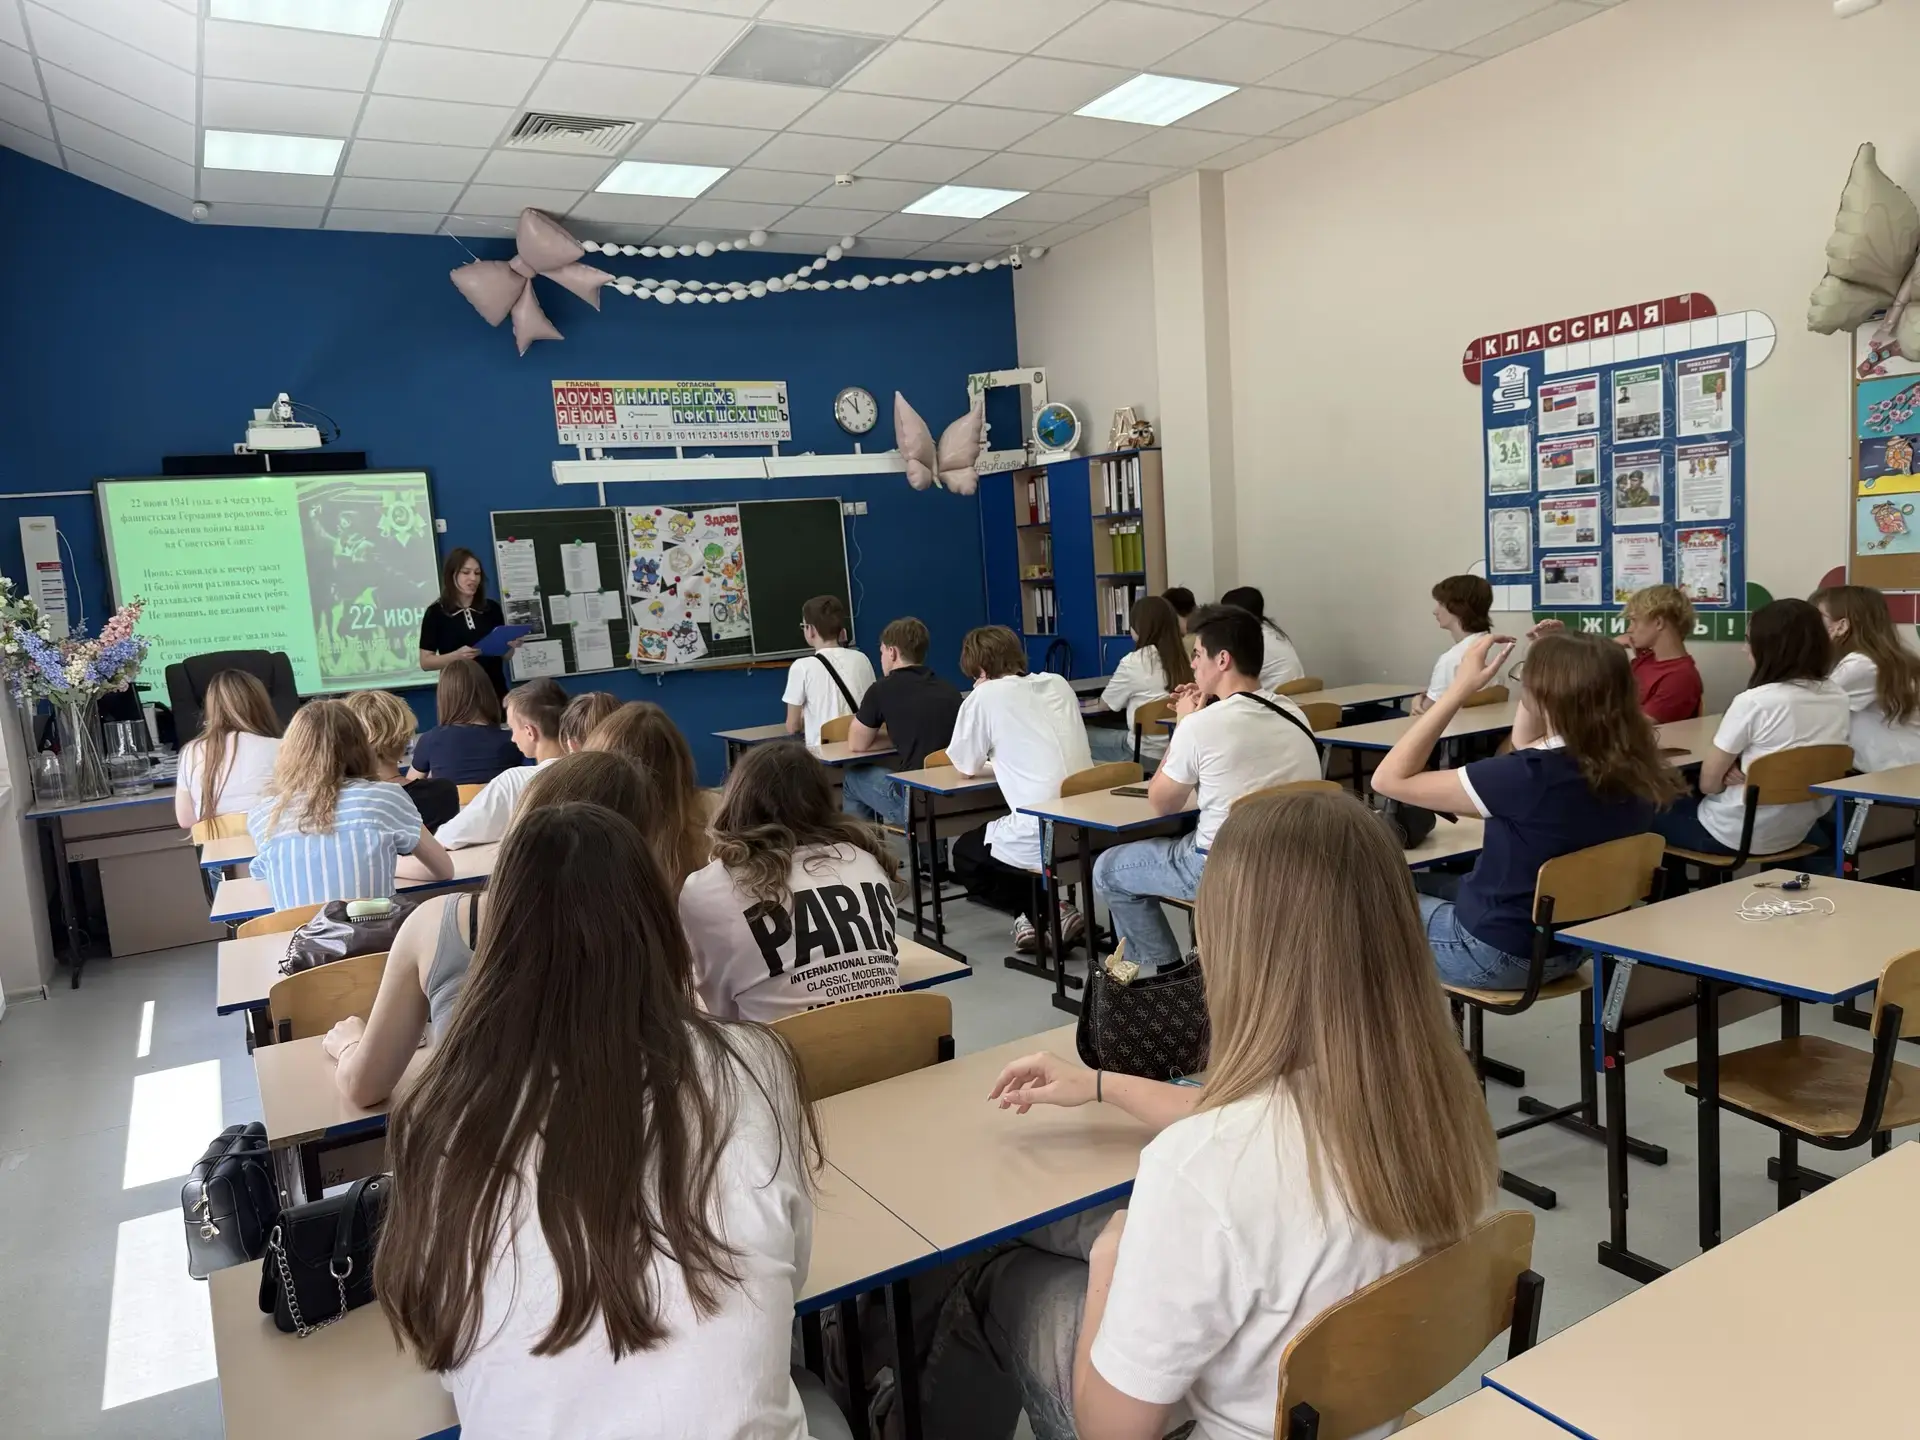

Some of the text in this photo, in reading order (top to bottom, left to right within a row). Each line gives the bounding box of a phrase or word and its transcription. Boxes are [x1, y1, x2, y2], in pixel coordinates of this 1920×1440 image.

[1485, 305, 1658, 356] КЛАССНАЯ
[131, 498, 140, 508] 22
[170, 497, 188, 506] 1941
[179, 511, 222, 523] Германия
[704, 514, 738, 527] Здрав
[724, 527, 738, 536] ле
[228, 565, 256, 575] вечеру
[144, 583, 151, 592] И
[154, 582, 179, 591] белой
[148, 610, 161, 620] Не
[349, 605, 425, 629] 22 июн
[743, 882, 898, 977] PARIS
[790, 956, 867, 984] INTERNATIONAL
[806, 974, 850, 992] CLASSIC,
[852, 968, 887, 980] MODERN
